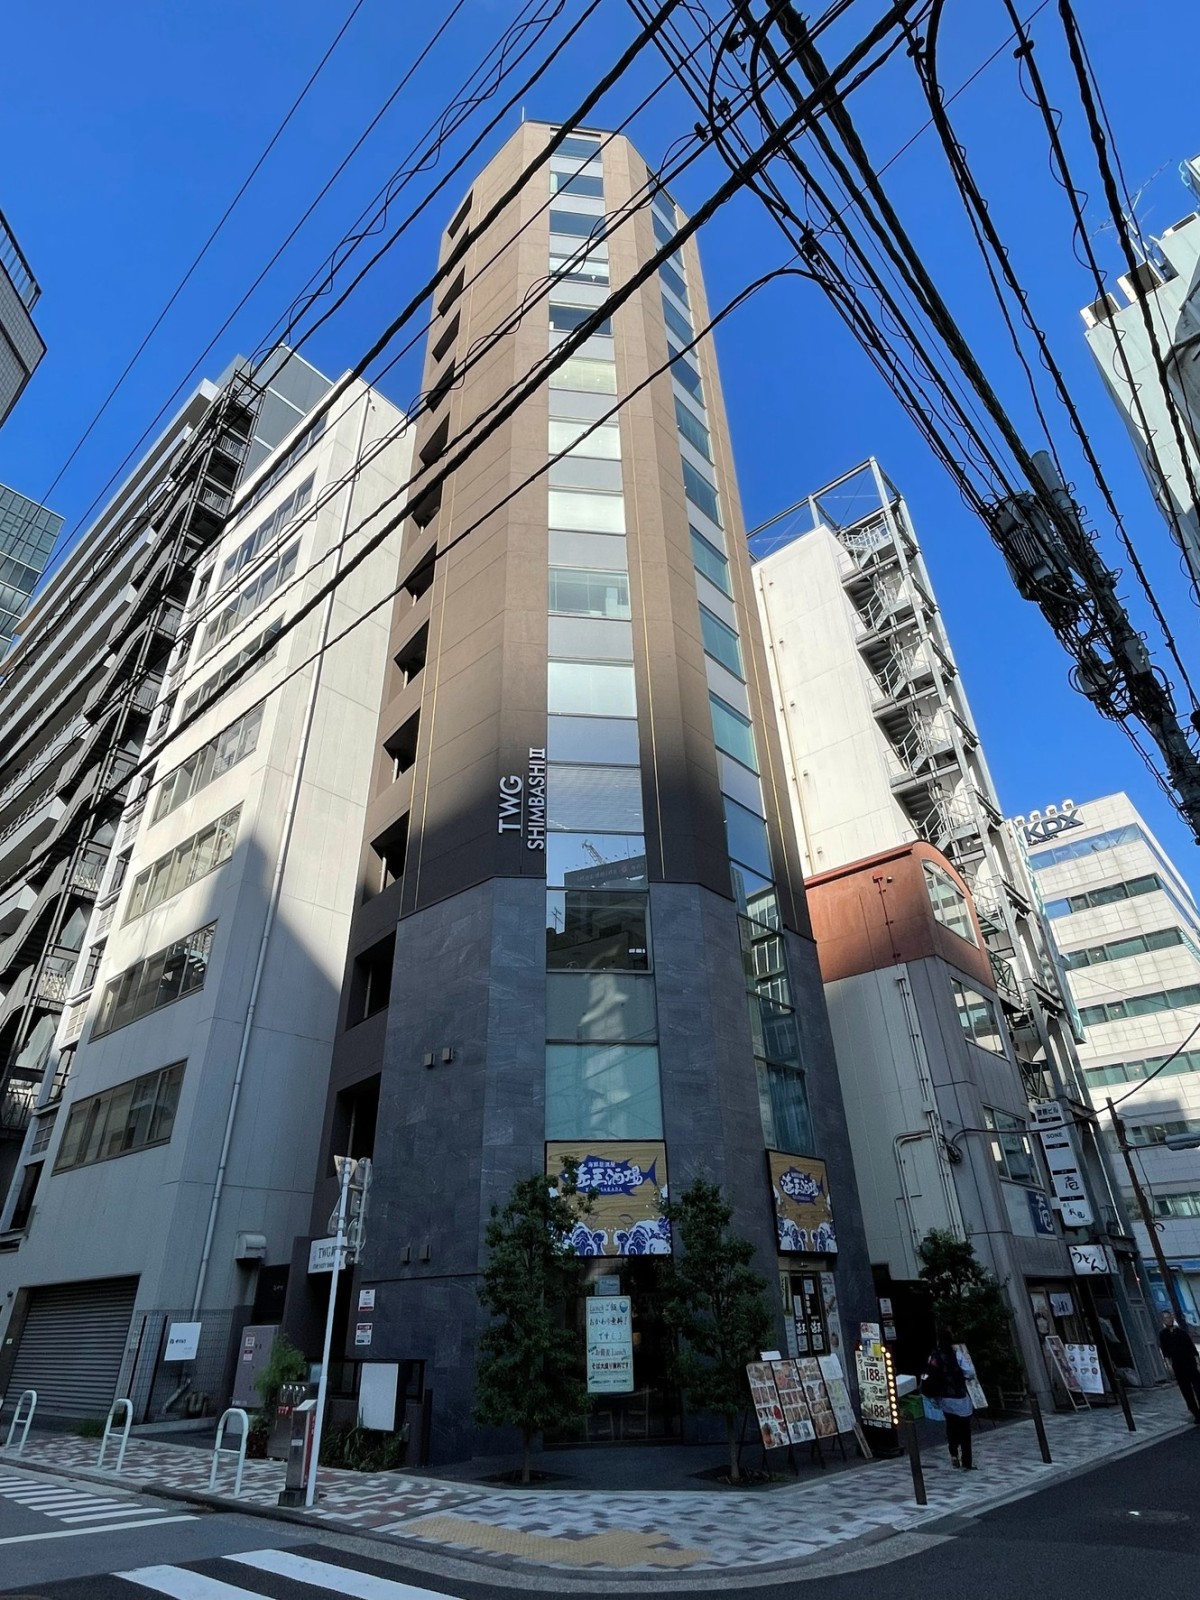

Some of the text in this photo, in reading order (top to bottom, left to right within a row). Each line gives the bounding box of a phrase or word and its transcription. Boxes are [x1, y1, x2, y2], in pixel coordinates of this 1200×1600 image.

[498, 775, 522, 834] TWG
[527, 760, 545, 850] SHIMBASHI
[1023, 808, 1084, 841] KDX
[1071, 1247, 1108, 1273] うどん
